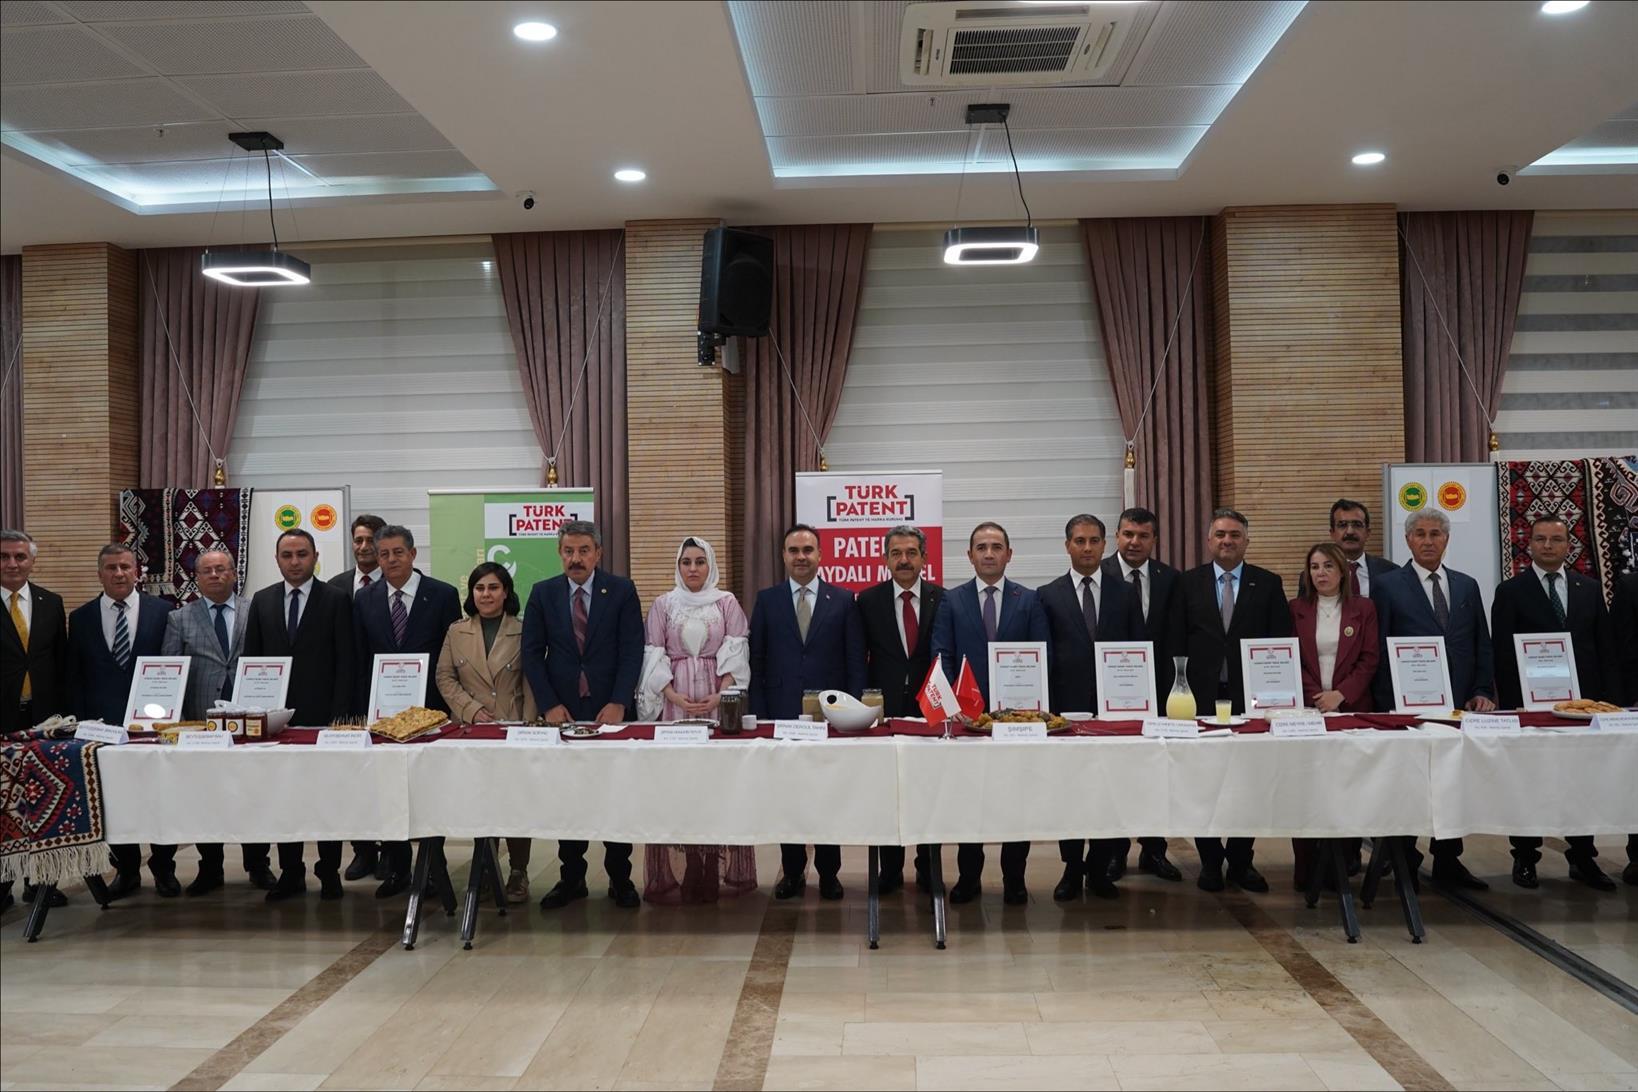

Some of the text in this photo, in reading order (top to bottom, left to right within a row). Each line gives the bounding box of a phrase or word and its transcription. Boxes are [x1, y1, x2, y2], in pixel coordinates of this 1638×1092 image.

[845, 485, 898, 499] TÜRK
[523, 505, 565, 517] TÜRK
[836, 501, 908, 516] PATENT
[516, 519, 572, 531] PATEN
[834, 536, 886, 558] PATE
[817, 565, 871, 583] AYDALI
